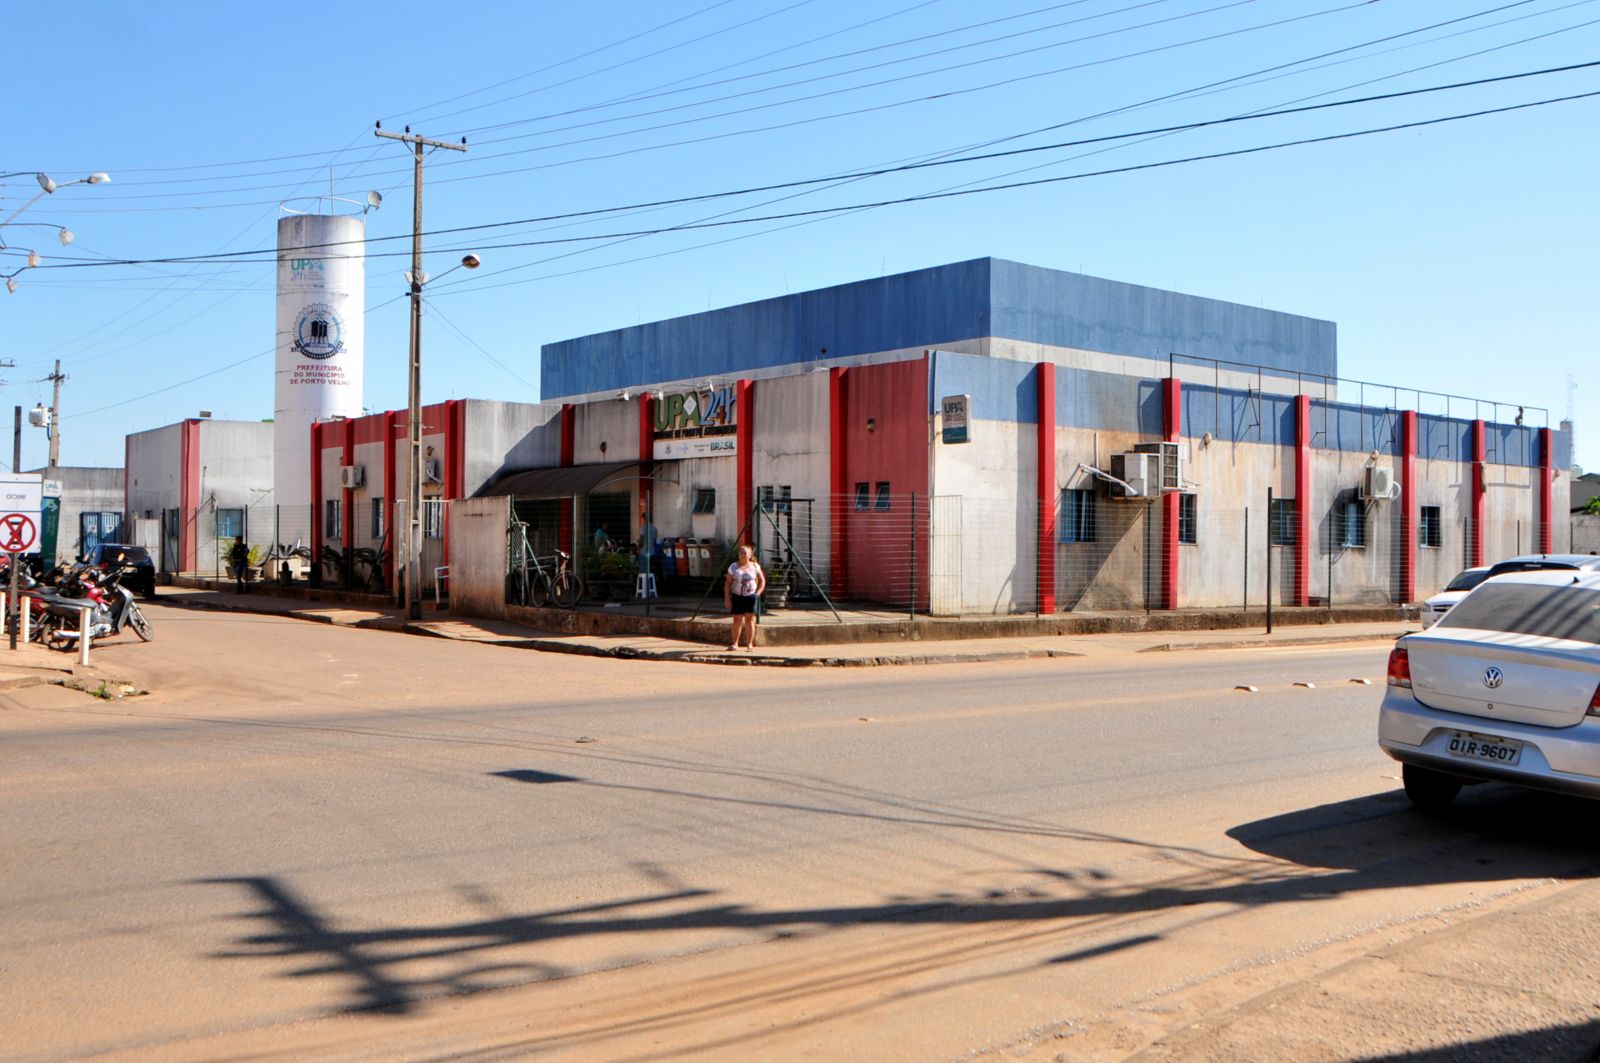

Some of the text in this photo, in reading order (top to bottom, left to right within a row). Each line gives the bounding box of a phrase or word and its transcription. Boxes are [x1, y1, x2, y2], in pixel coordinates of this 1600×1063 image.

[291, 257, 324, 271] UPA
[296, 364, 343, 372] PREFEITURA
[653, 391, 701, 431] UPA
[944, 402, 964, 414] UPA
